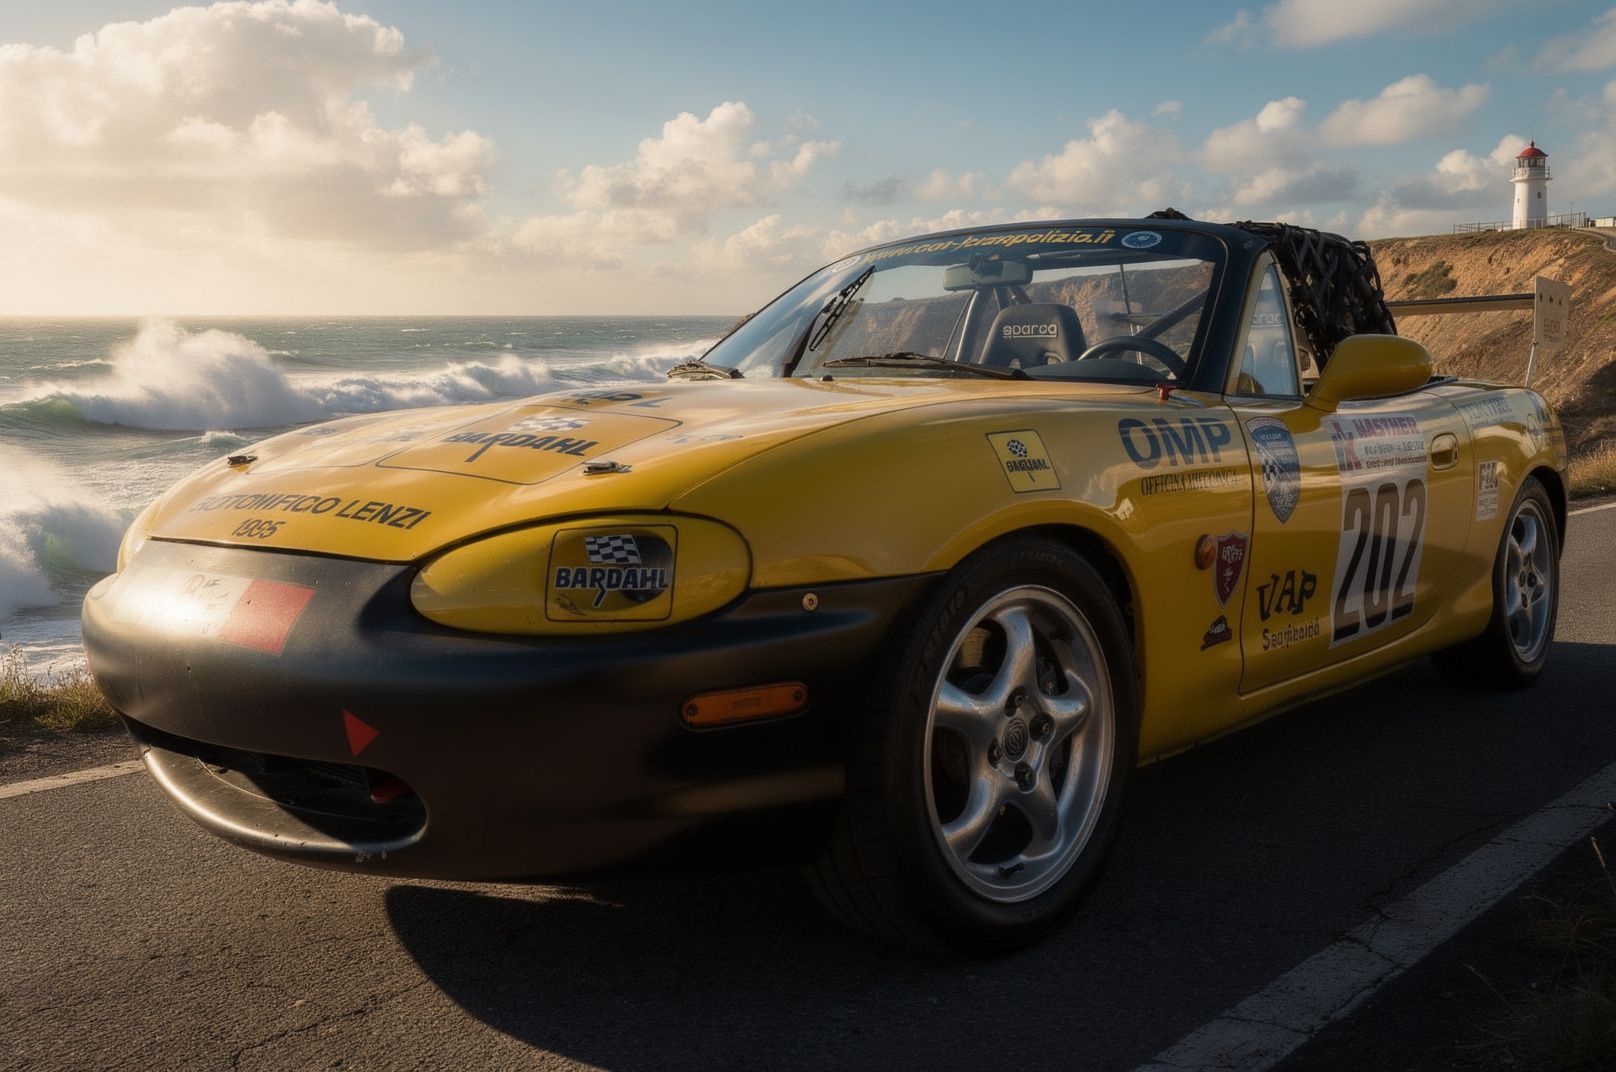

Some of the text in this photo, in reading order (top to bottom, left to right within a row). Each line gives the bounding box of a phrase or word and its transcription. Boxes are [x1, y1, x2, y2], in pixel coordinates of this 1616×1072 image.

[1118, 417, 1231, 470] OMP
[335, 500, 432, 530] LENZI
[1333, 478, 1426, 642] 202
[554, 566, 669, 608] BARDAHL
[1256, 569, 1317, 622] VAP
